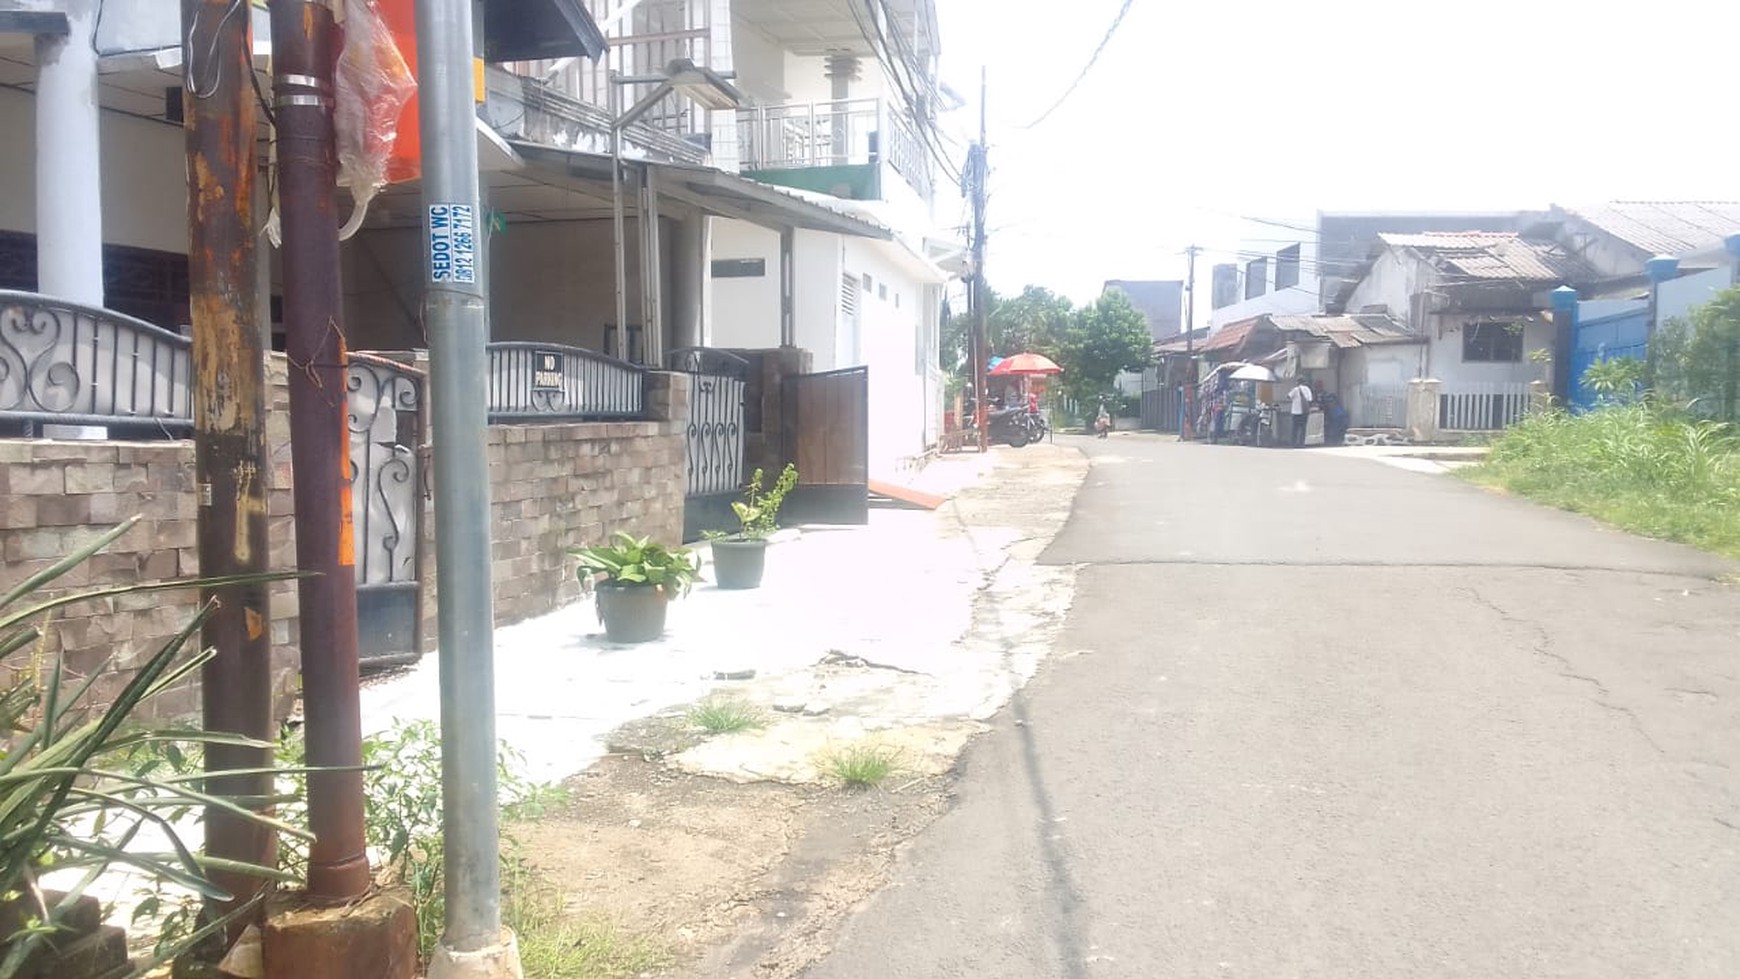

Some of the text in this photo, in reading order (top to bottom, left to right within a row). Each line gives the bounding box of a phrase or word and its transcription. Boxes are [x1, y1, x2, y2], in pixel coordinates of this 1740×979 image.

[451, 206, 472, 229] 7172
[430, 206, 451, 279] SEDOT WC
[544, 355, 556, 370] NO
[535, 371, 562, 387] PARKING
